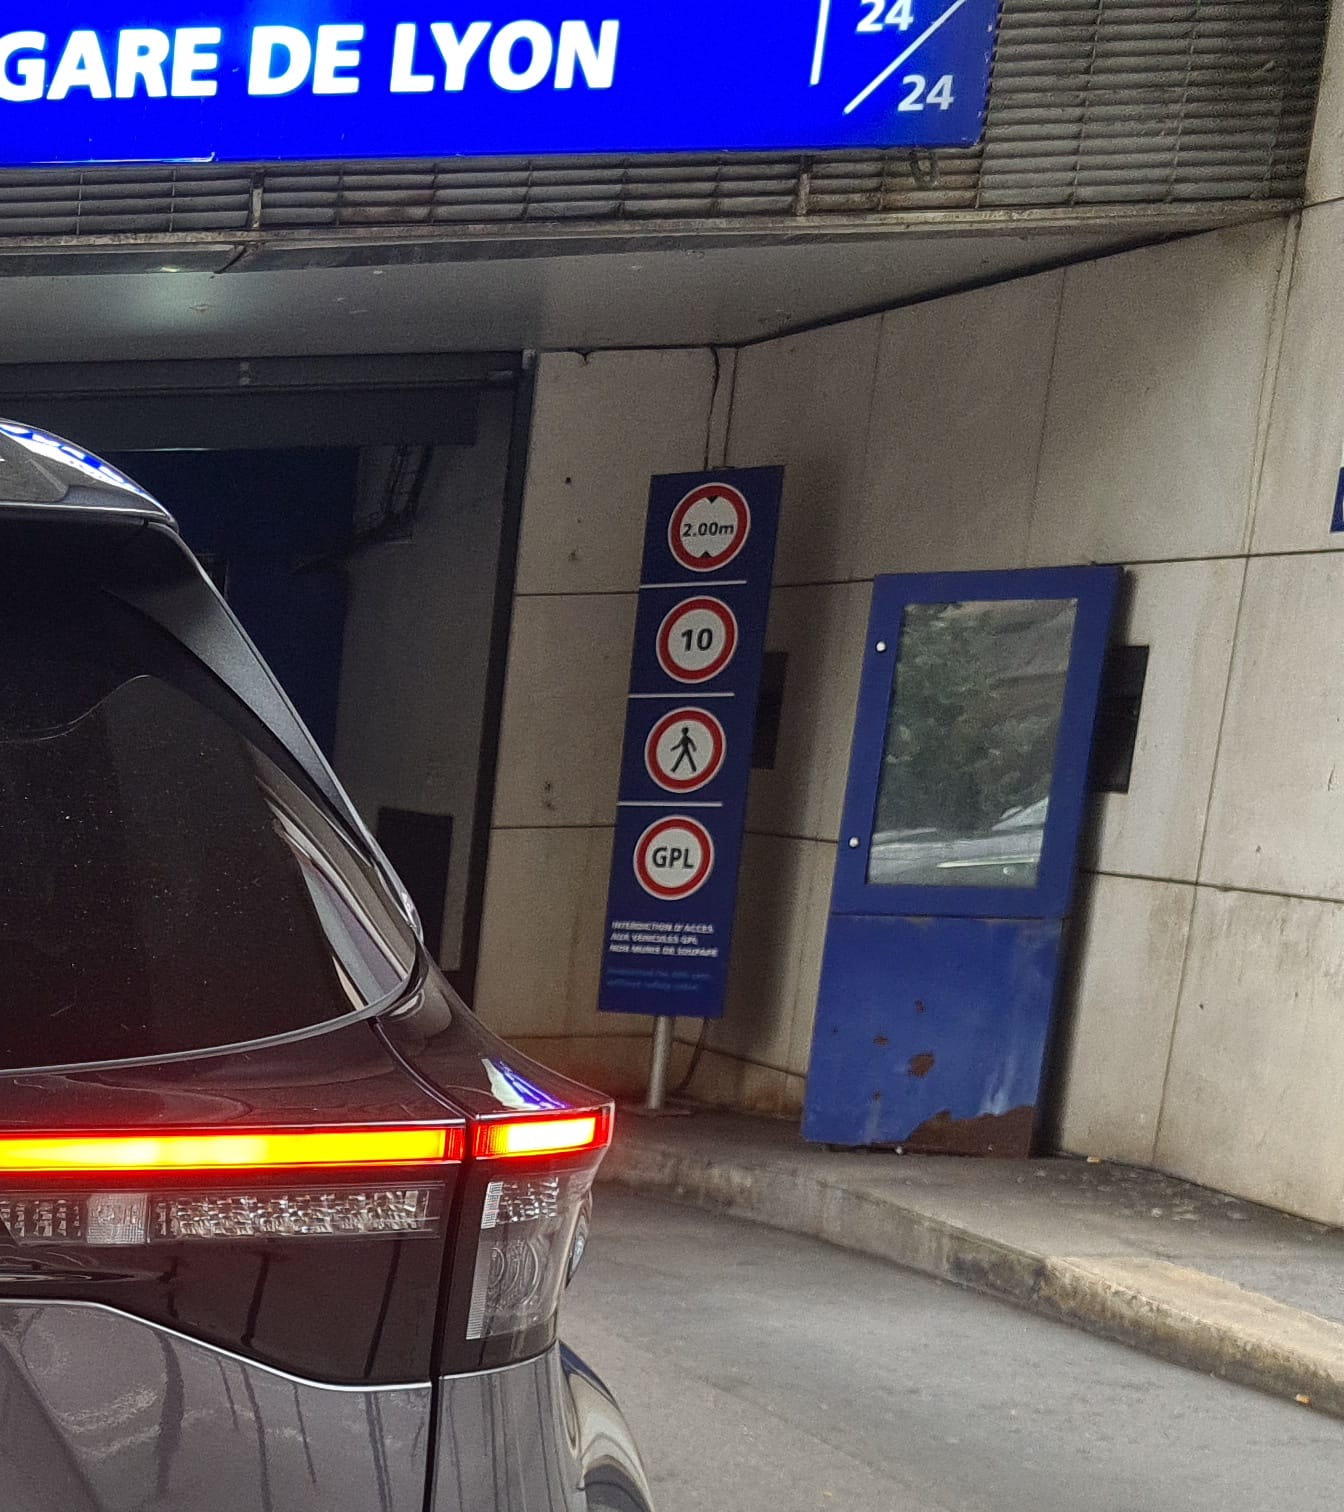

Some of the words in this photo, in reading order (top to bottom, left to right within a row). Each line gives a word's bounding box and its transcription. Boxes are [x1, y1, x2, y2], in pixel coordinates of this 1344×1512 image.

[855, 0, 914, 32] 24
[248, 23, 365, 96] DE
[389, 19, 619, 92] LYON
[897, 74, 954, 112] 24
[682, 521, 734, 538] 2.00m
[680, 628, 713, 652] 10
[652, 846, 695, 869] GPL
